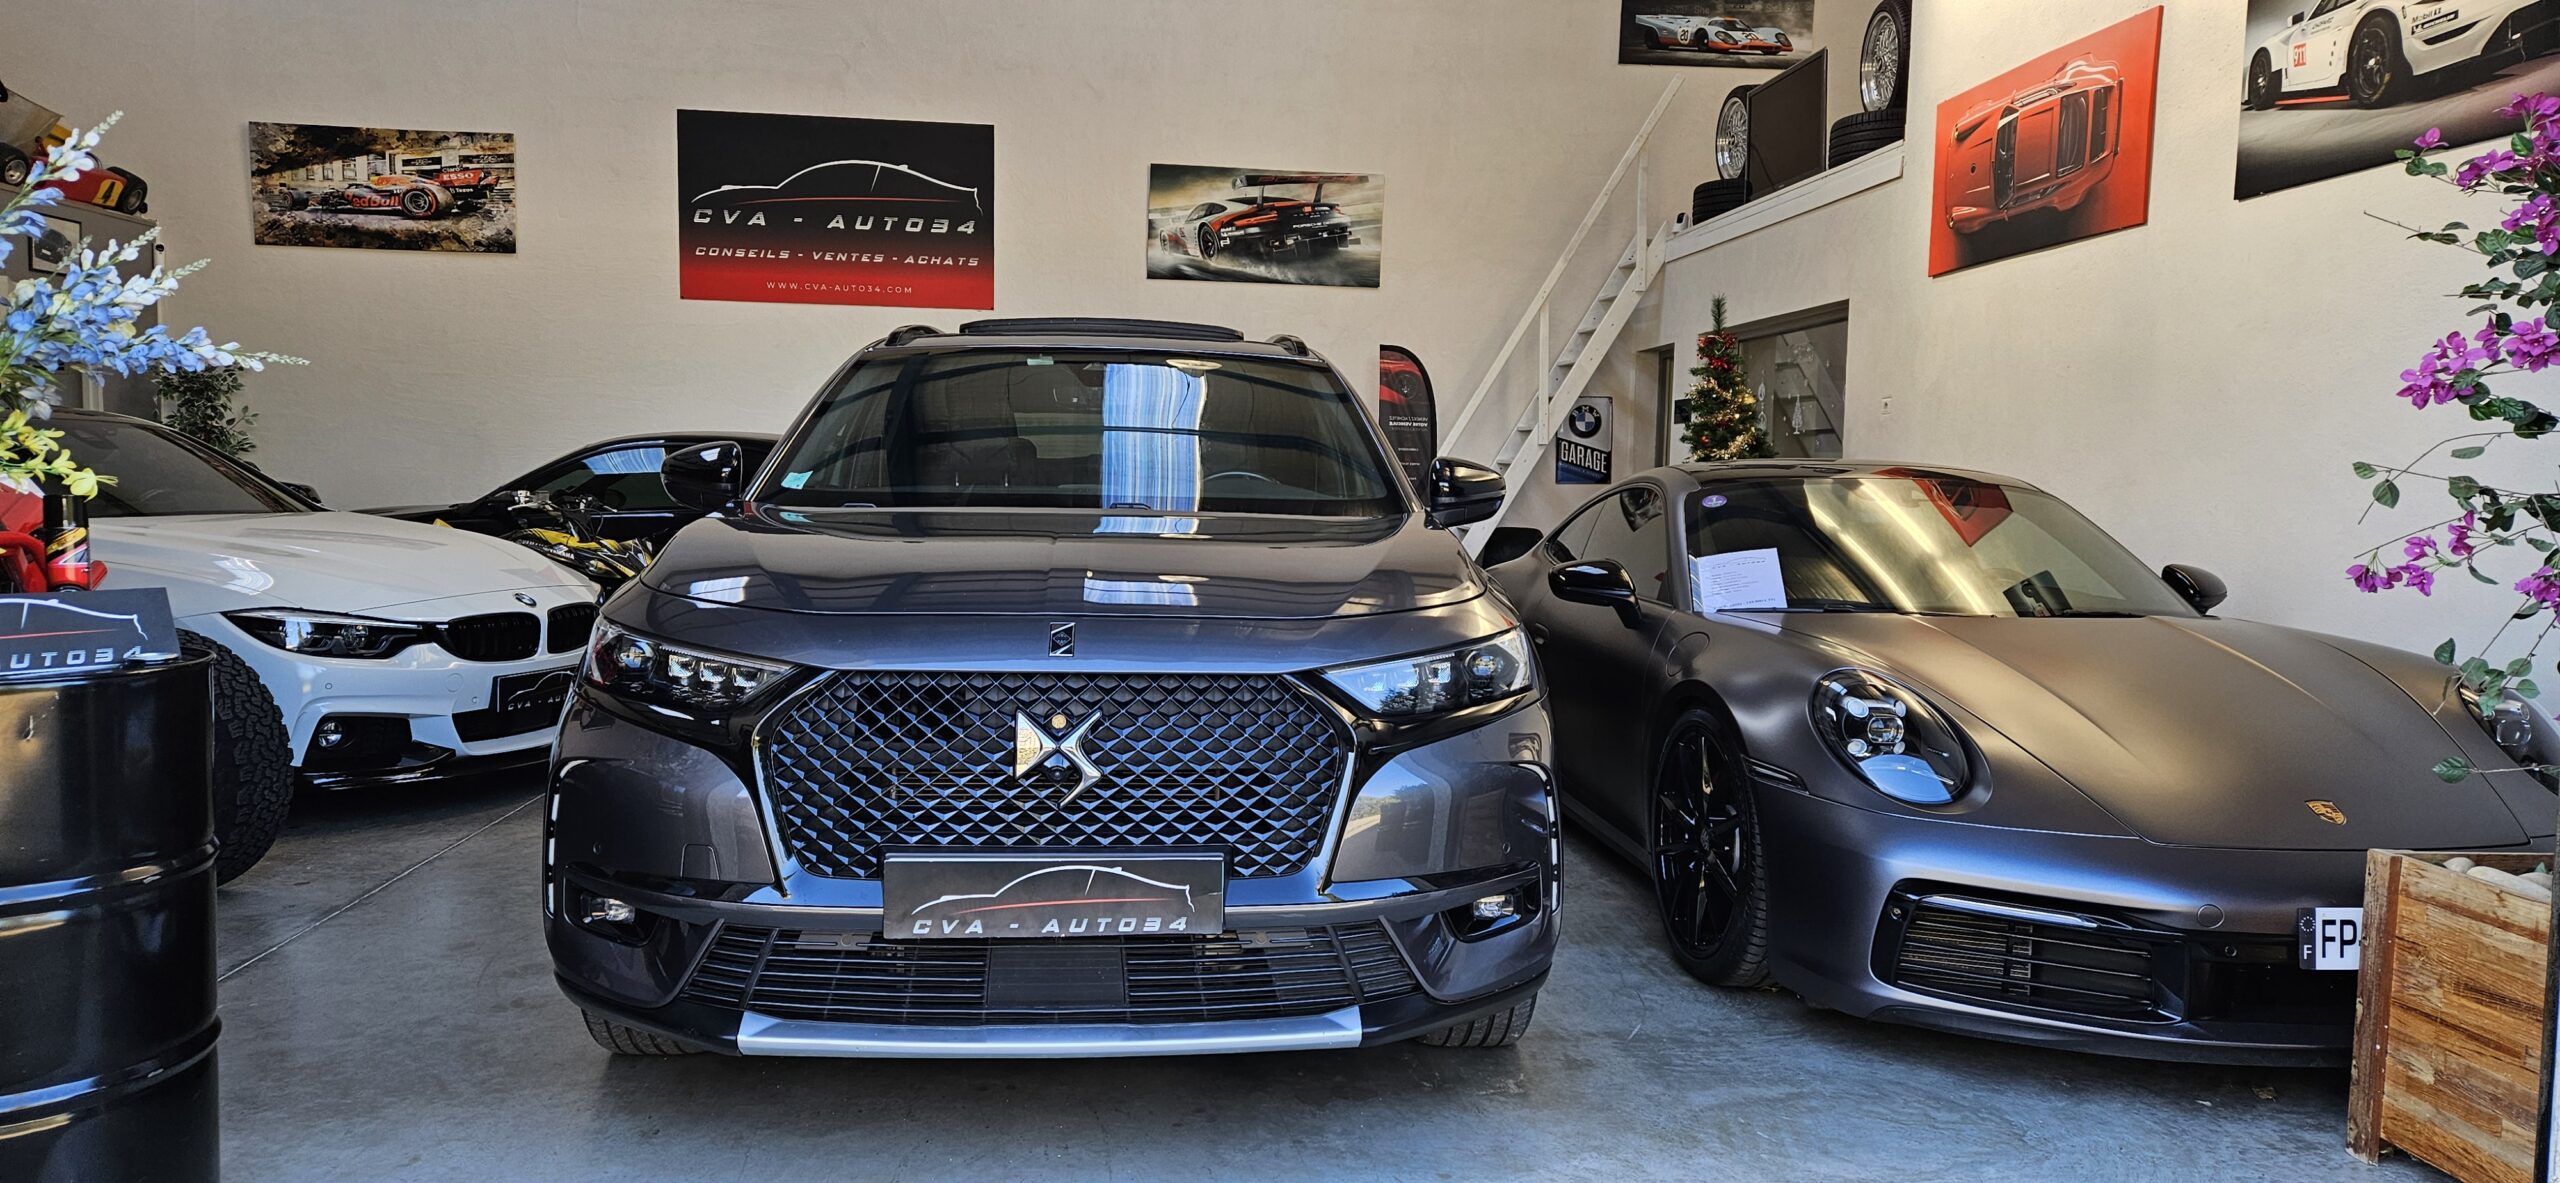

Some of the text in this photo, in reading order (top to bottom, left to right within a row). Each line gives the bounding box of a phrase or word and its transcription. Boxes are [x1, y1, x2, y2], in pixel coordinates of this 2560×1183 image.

[443, 172, 474, 180] ESSO
[693, 208, 766, 226] CVA
[827, 215, 976, 235] AUTO34
[695, 246, 790, 260] CONSEILS
[812, 251, 885, 263] VENTES
[904, 255, 980, 267] ACHATS
[766, 281, 912, 294] WWW.CVA-AUTO34.COM
[1571, 405, 1600, 418] BMW
[1561, 441, 1608, 473] GARAGE
[508, 701, 531, 711] CVA
[912, 919, 983, 934] CVA
[1042, 917, 1188, 934] AUTO34
[2303, 944, 2312, 960] F
